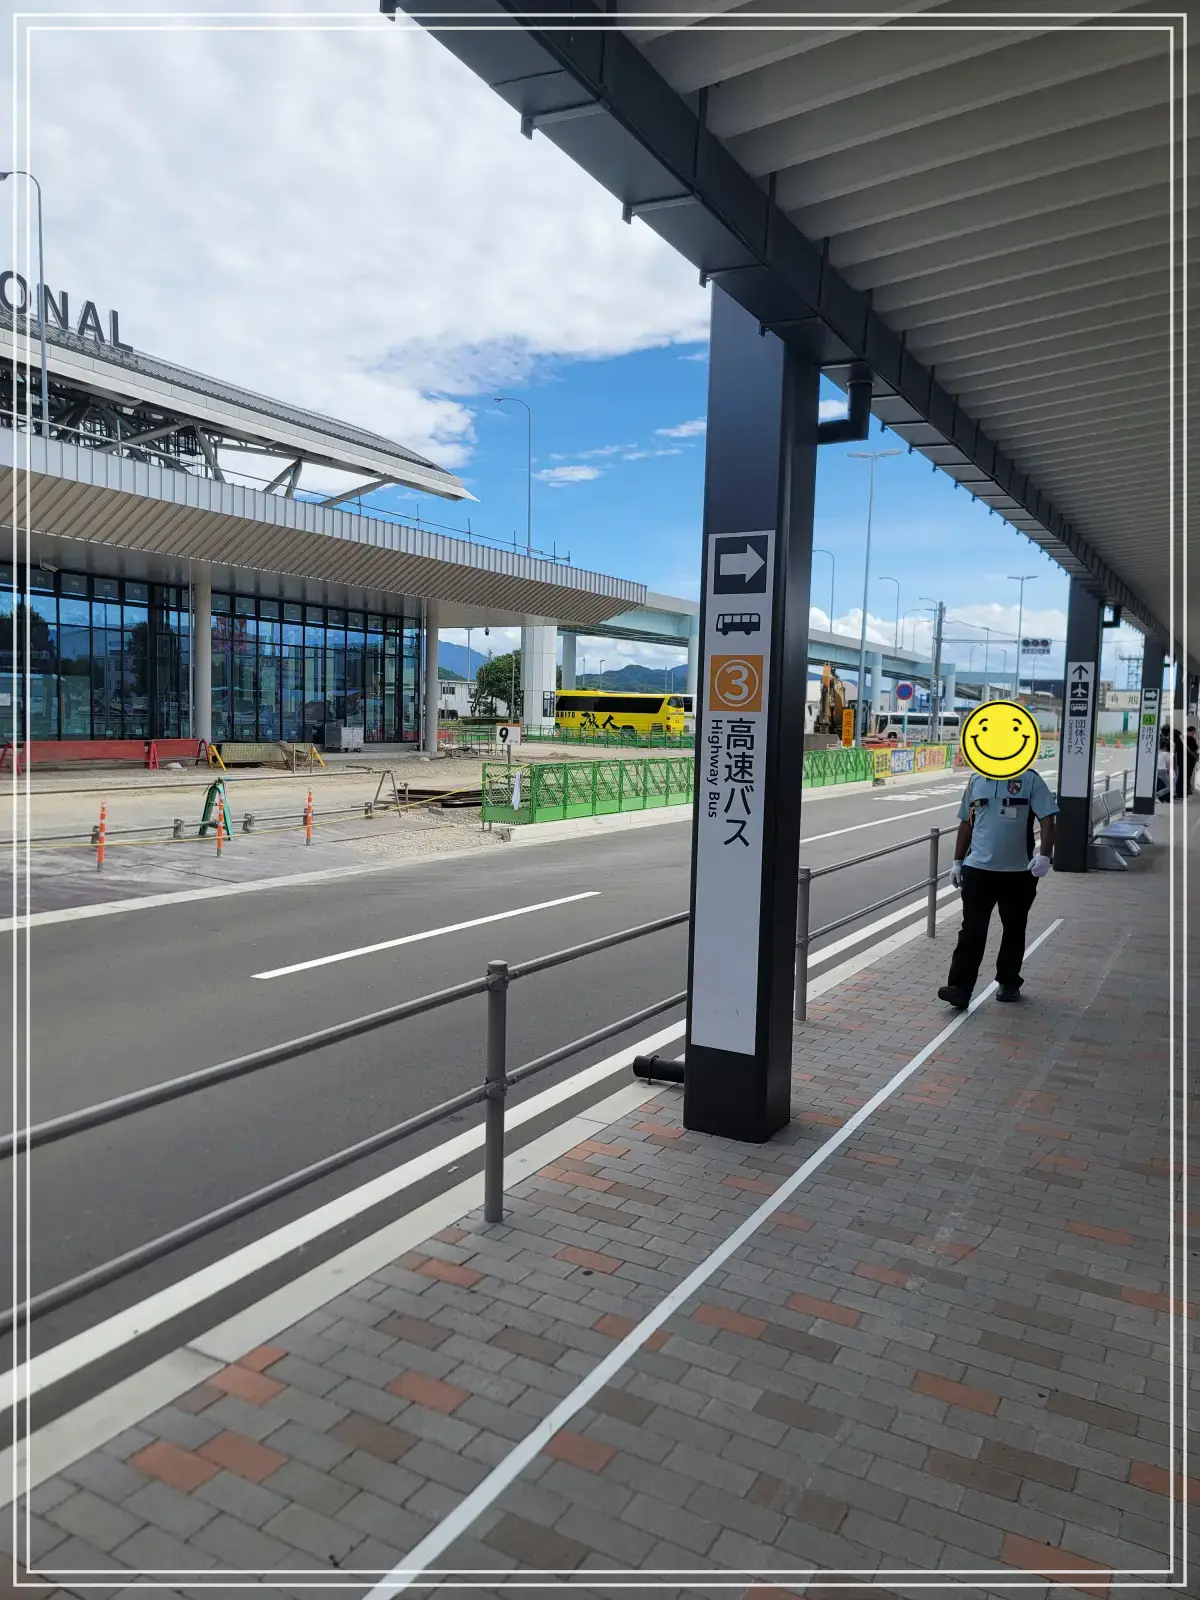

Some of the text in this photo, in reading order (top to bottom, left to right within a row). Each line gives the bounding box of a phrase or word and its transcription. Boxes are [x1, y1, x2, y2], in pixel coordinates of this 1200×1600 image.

[0, 270, 133, 353] ONAL
[498, 726, 509, 744] 9
[707, 720, 723, 818] Highway Bus
[1074, 719, 1086, 755] 団体バス
[724, 718, 756, 847] 高速バス
